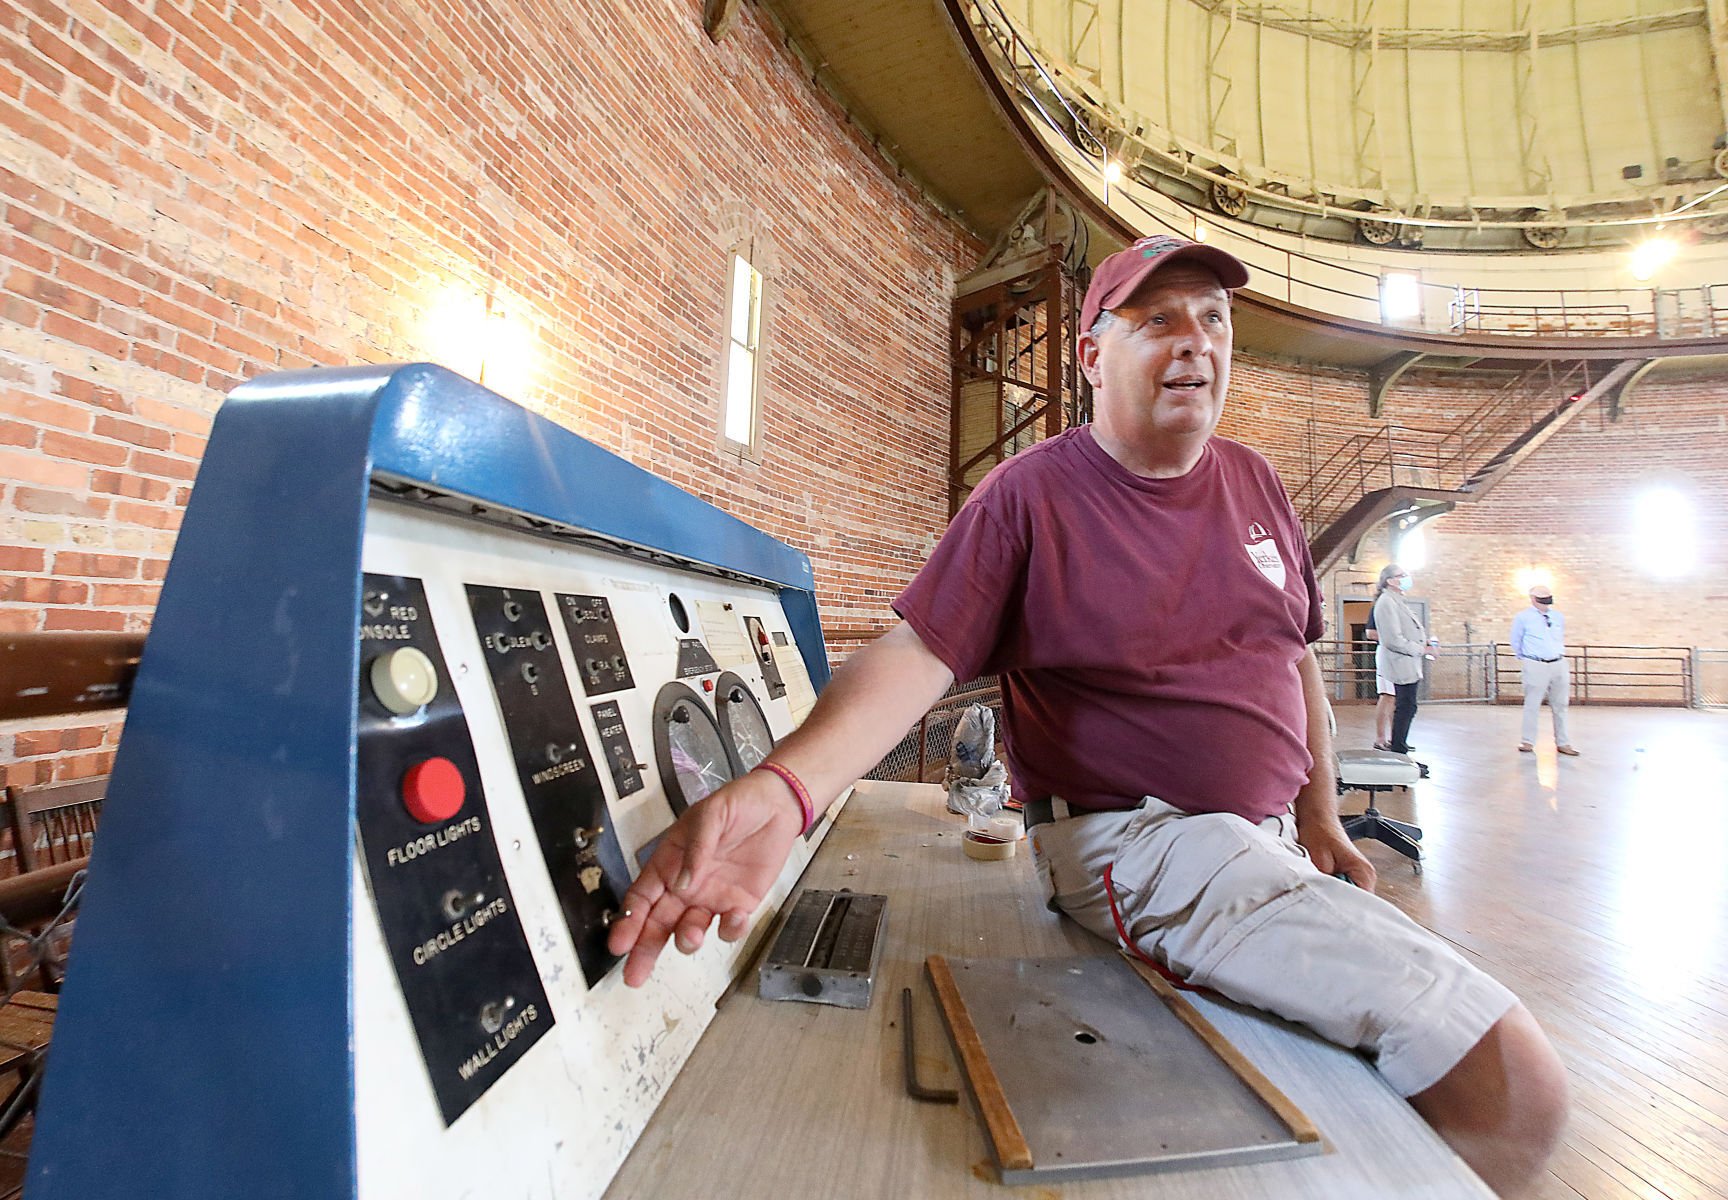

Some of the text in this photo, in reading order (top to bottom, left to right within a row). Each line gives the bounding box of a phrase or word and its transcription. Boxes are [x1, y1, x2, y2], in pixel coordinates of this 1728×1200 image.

[390, 606, 418, 621] RED
[531, 758, 586, 785] WINDSCREEN
[387, 815, 482, 867] FLOOR LIGHTS
[412, 897, 508, 966] CIRCLE LIGHTS
[457, 1003, 539, 1081] WALL LIGHTS
